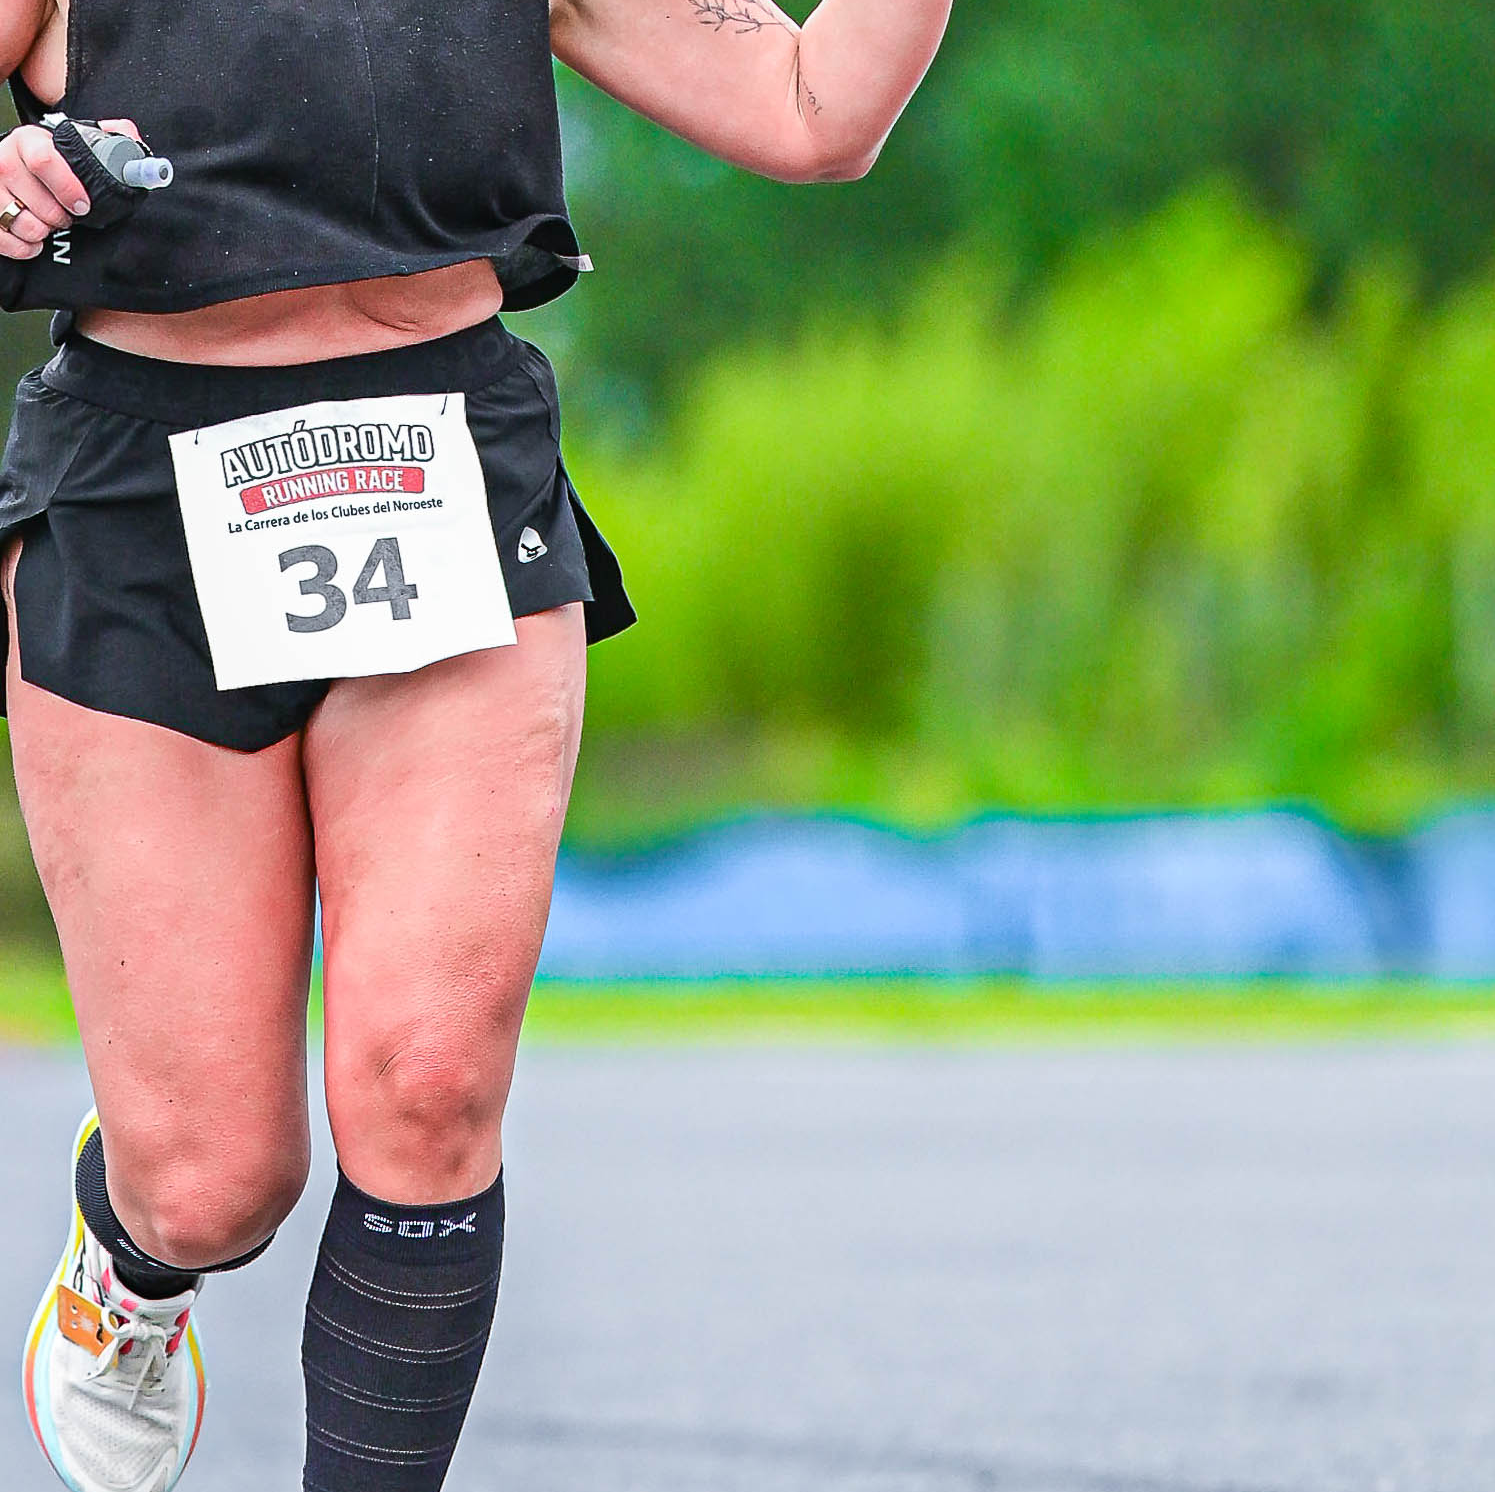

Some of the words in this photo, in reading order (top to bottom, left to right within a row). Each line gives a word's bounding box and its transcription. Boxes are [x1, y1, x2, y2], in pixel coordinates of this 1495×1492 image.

[220, 420, 435, 488] AUTÓDROMO
[261, 473, 350, 507] RUNNING
[354, 468, 405, 492] RACE
[227, 521, 243, 534] La
[244, 514, 291, 532] Carrera
[293, 511, 309, 524] de
[311, 508, 329, 521] los
[331, 503, 371, 518] Clubes
[373, 500, 391, 514] del
[392, 497, 444, 512] Noroeste
[278, 537, 418, 633] 34
[363, 1211, 478, 1238] SOX
